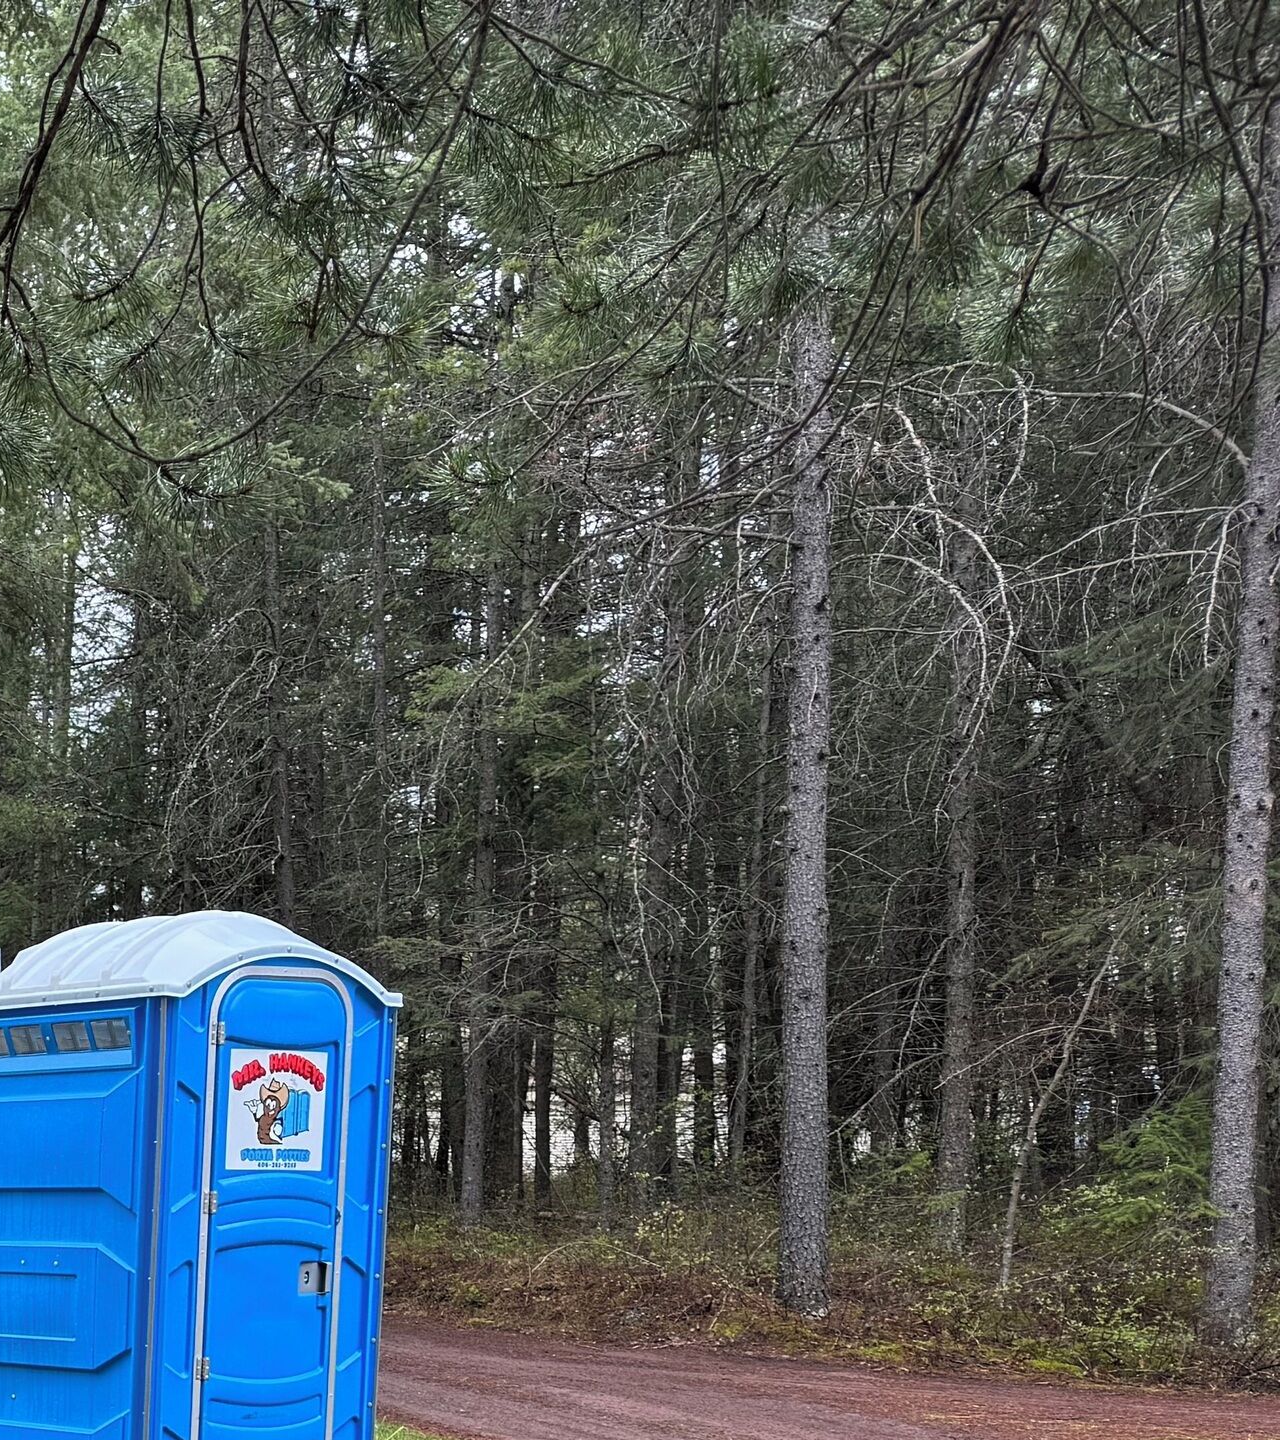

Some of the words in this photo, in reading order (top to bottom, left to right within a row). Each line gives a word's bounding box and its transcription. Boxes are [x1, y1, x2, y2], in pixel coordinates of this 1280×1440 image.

[232, 1059, 266, 1090] MR.
[269, 1053, 325, 1092] HANKEYS
[240, 1148, 273, 1161] PORTA
[275, 1148, 311, 1162] POTTIES
